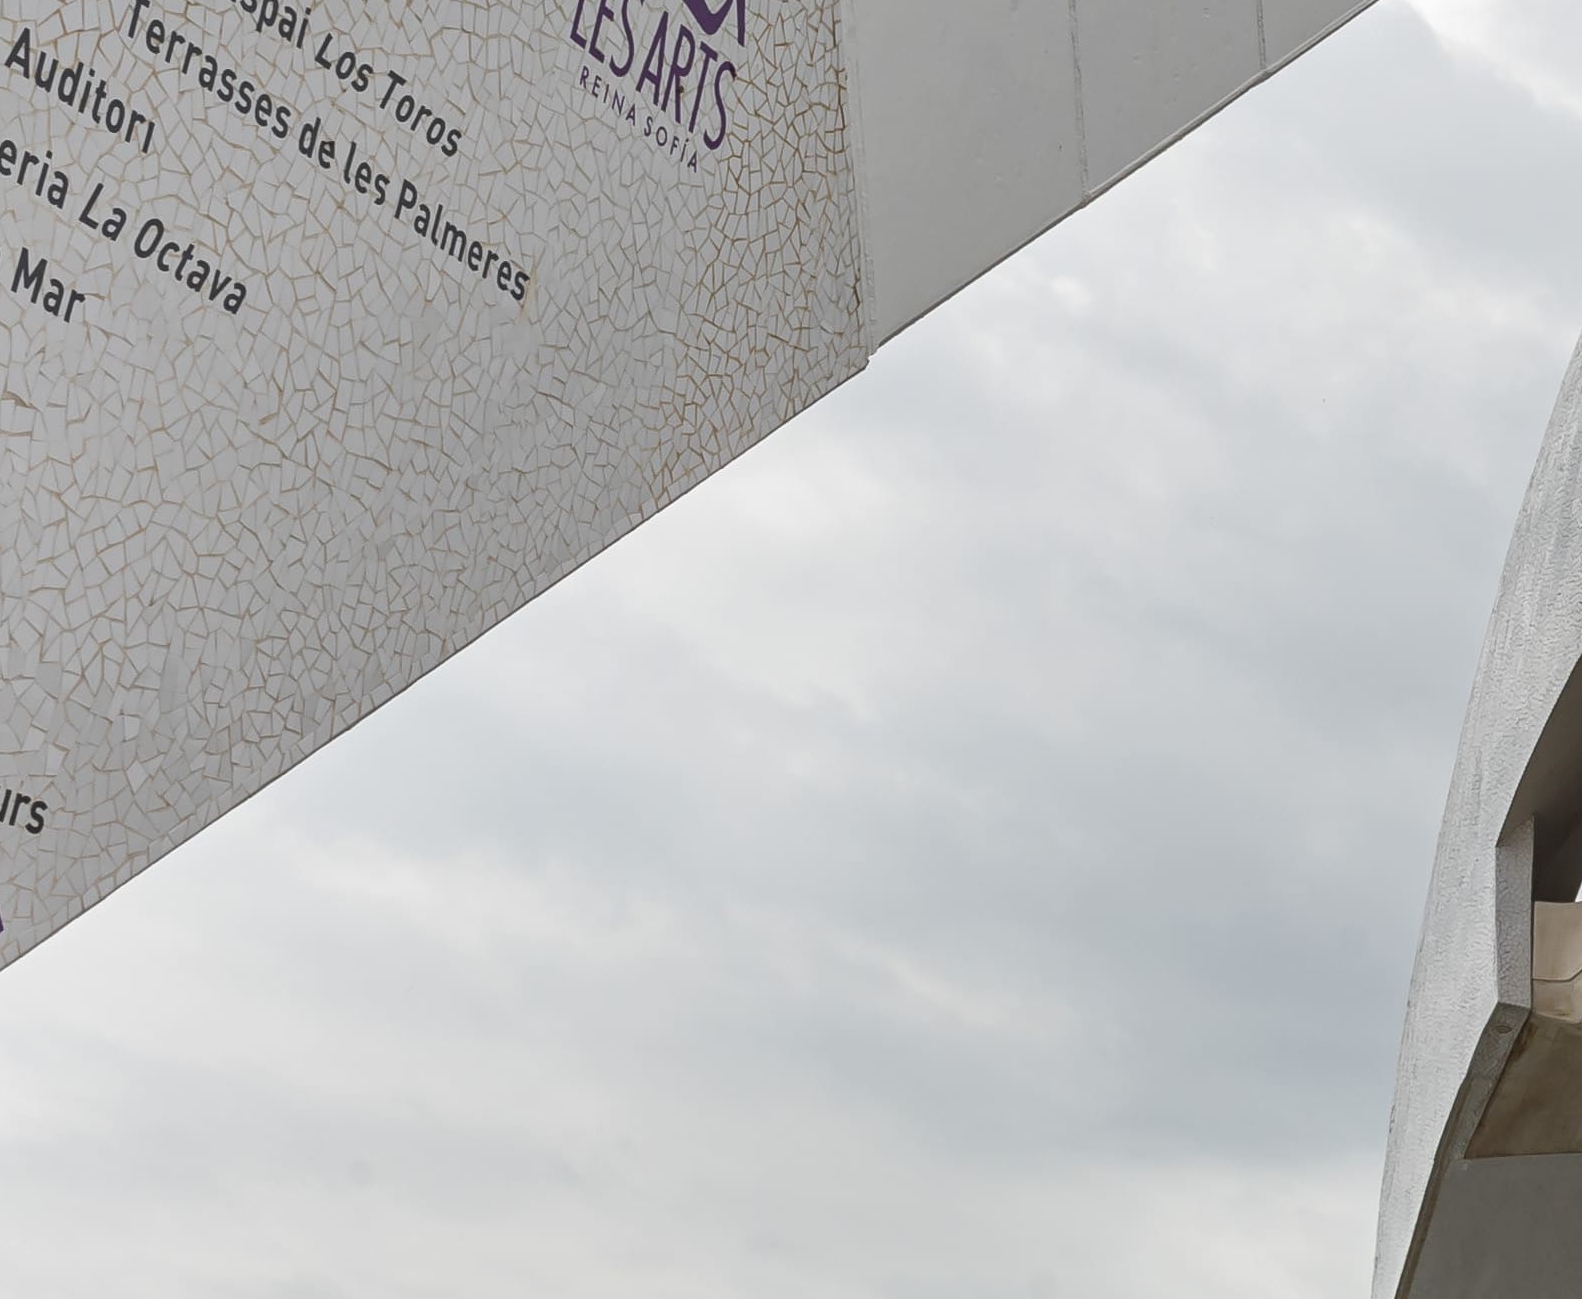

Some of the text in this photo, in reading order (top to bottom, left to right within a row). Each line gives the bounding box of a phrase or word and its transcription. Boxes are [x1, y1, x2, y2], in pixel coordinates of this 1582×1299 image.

[5, 28, 155, 153] Auditori
[315, 33, 373, 92] Los
[380, 70, 461, 157] Toros
[579, 65, 699, 173] REINA SOFÍA
[636, 11, 737, 150] ARTS
[79, 184, 126, 241] La
[135, 219, 246, 314] Octava
[299, 117, 335, 168] de
[344, 142, 390, 205] les
[394, 179, 530, 300] Palmeres
[11, 248, 85, 322] Mar
